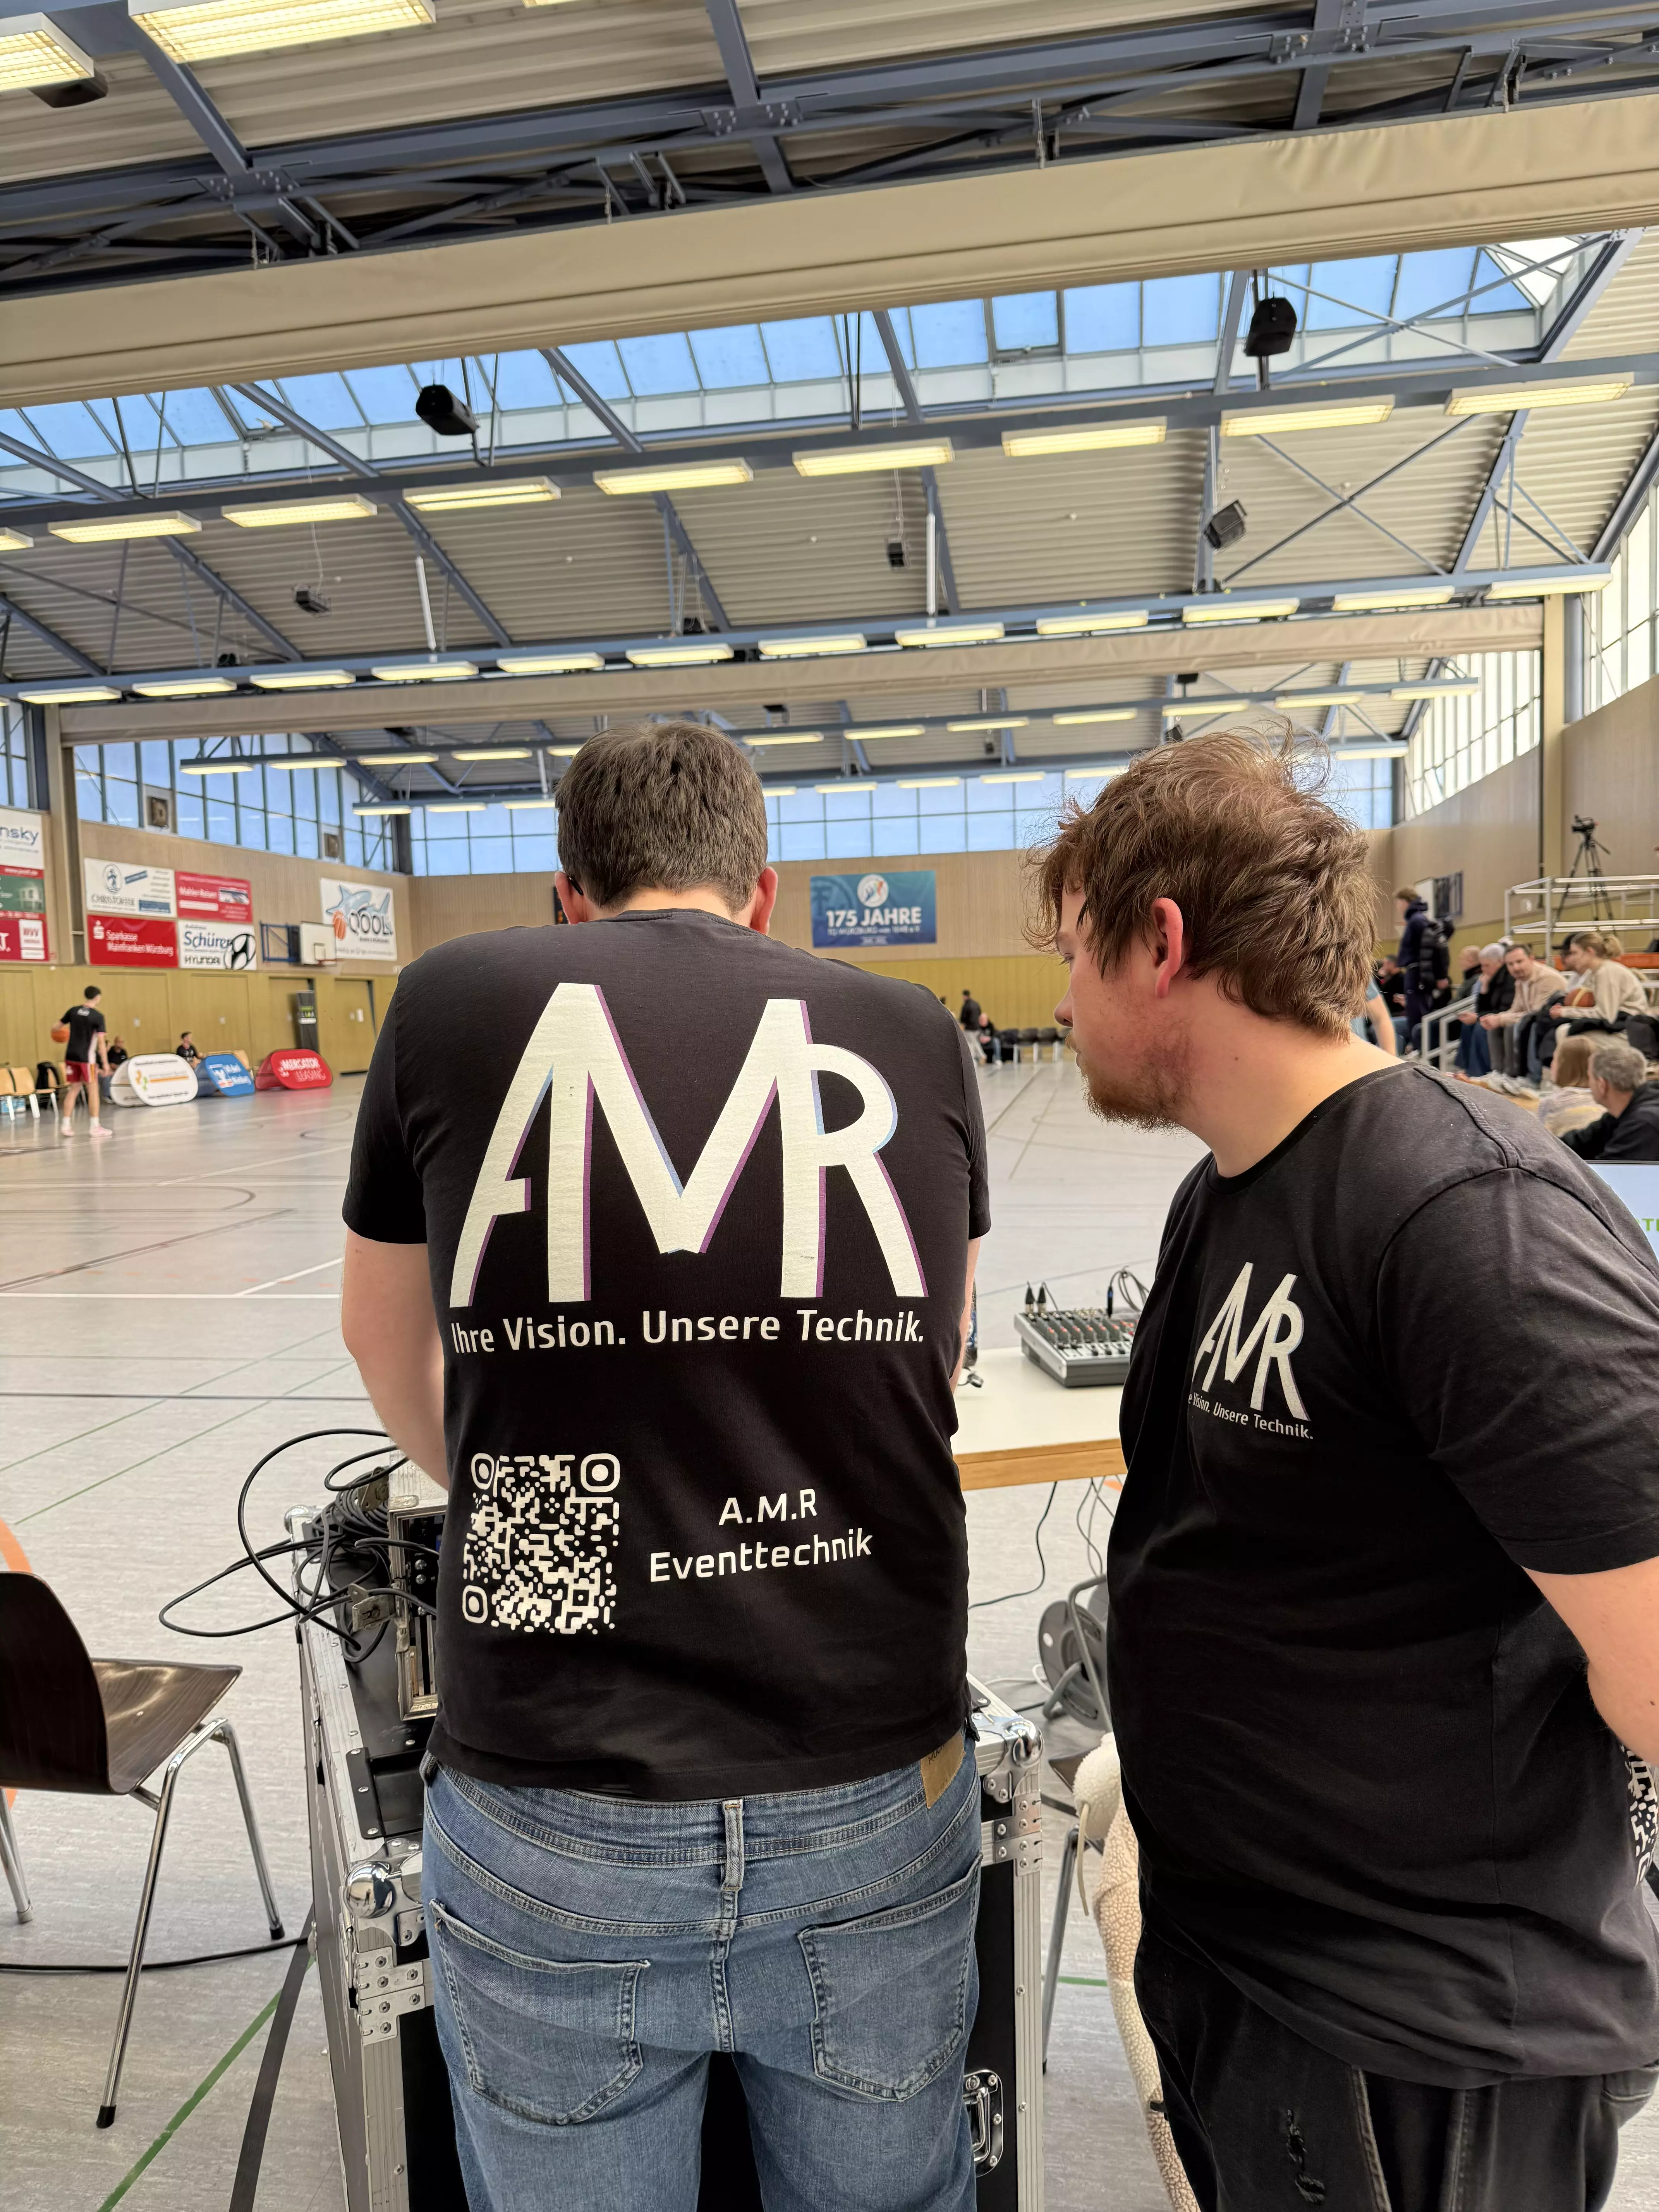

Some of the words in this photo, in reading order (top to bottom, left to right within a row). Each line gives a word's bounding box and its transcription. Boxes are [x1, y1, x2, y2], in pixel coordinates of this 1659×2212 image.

[826, 910, 857, 927] 175
[860, 907, 922, 926] JAHRE
[106, 929, 138, 941] Sparkasse
[107, 941, 144, 953] Mainfranken
[146, 943, 173, 957] Würzburg
[184, 931, 232, 949] Schürer
[280, 1057, 320, 1071] MERCATOR
[295, 1069, 326, 1082] LEASING
[450, 982, 929, 1308] AMR
[451, 1322, 495, 1353] Ihre
[503, 1315, 626, 1350] Vision.
[643, 1310, 780, 1343] Unsere
[797, 1309, 924, 1342] Technik.
[1191, 1262, 1312, 1422] AMR
[1193, 1392, 1210, 1413] Vision.
[1213, 1402, 1249, 1425] Unsere
[1254, 1413, 1314, 1439] Technik.
[718, 1488, 817, 1525] A.M.R
[650, 1527, 873, 1582] Eventtechnik
